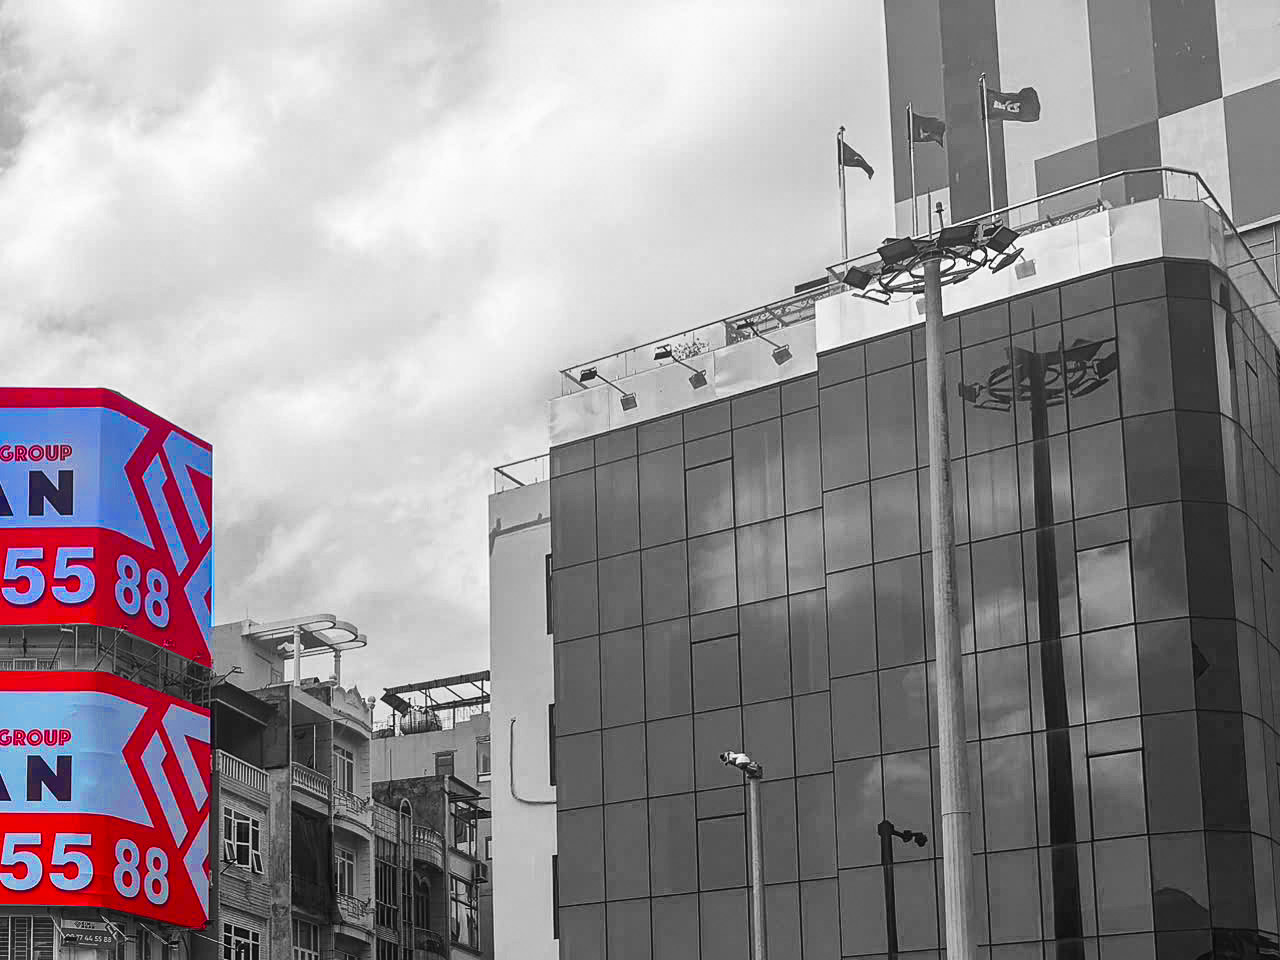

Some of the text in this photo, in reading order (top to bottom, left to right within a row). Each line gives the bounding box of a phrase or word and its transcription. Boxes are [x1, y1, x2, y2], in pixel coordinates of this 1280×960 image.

[1, 546, 96, 605] 55
[114, 554, 170, 628] 88
[113, 838, 169, 905] 88
